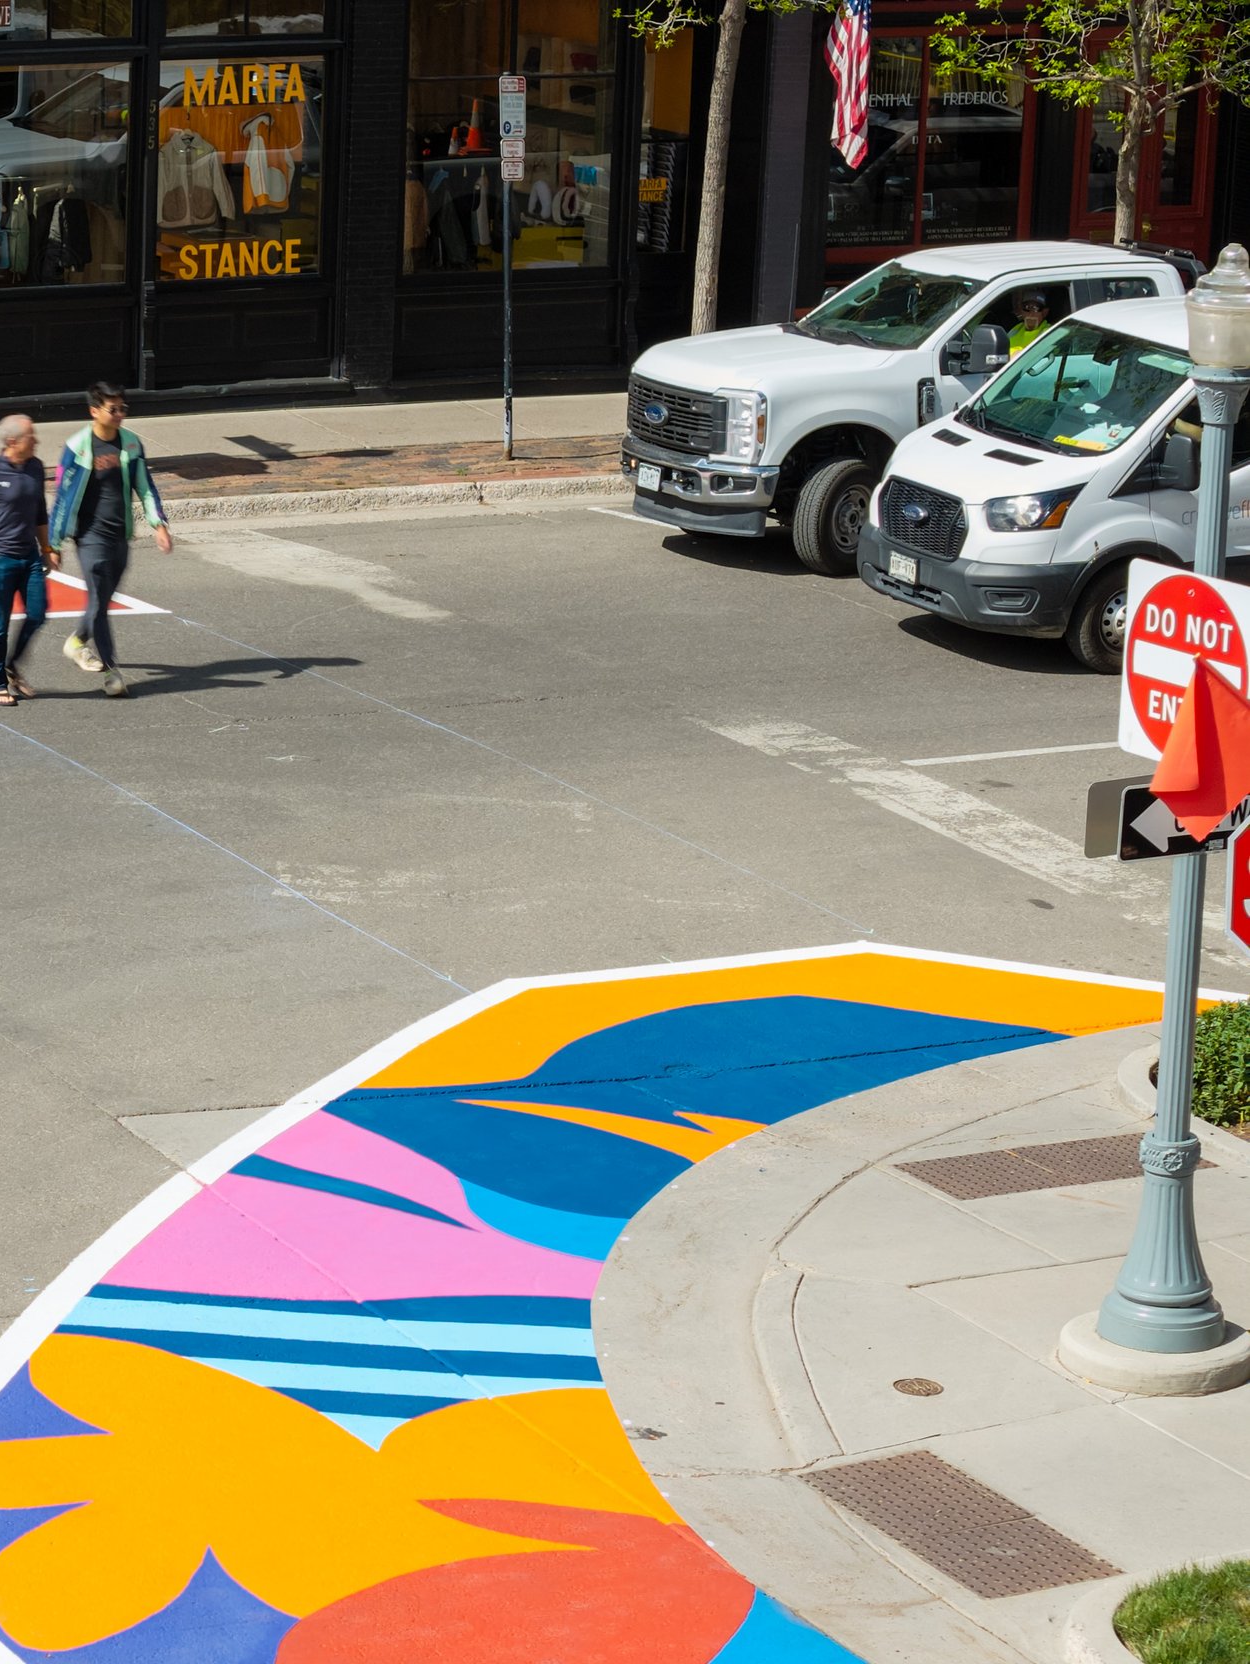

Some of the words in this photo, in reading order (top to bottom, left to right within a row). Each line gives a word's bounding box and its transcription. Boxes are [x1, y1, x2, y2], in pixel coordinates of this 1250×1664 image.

[182, 63, 307, 108] MARFA
[869, 93, 914, 108] ENTHAL
[943, 90, 1009, 106] FREDERICS
[912, 134, 943, 146] DTA
[639, 191, 664, 202] TANCE
[178, 238, 302, 281] STANCE
[1145, 603, 1176, 638] DO
[1185, 614, 1233, 653] NOT
